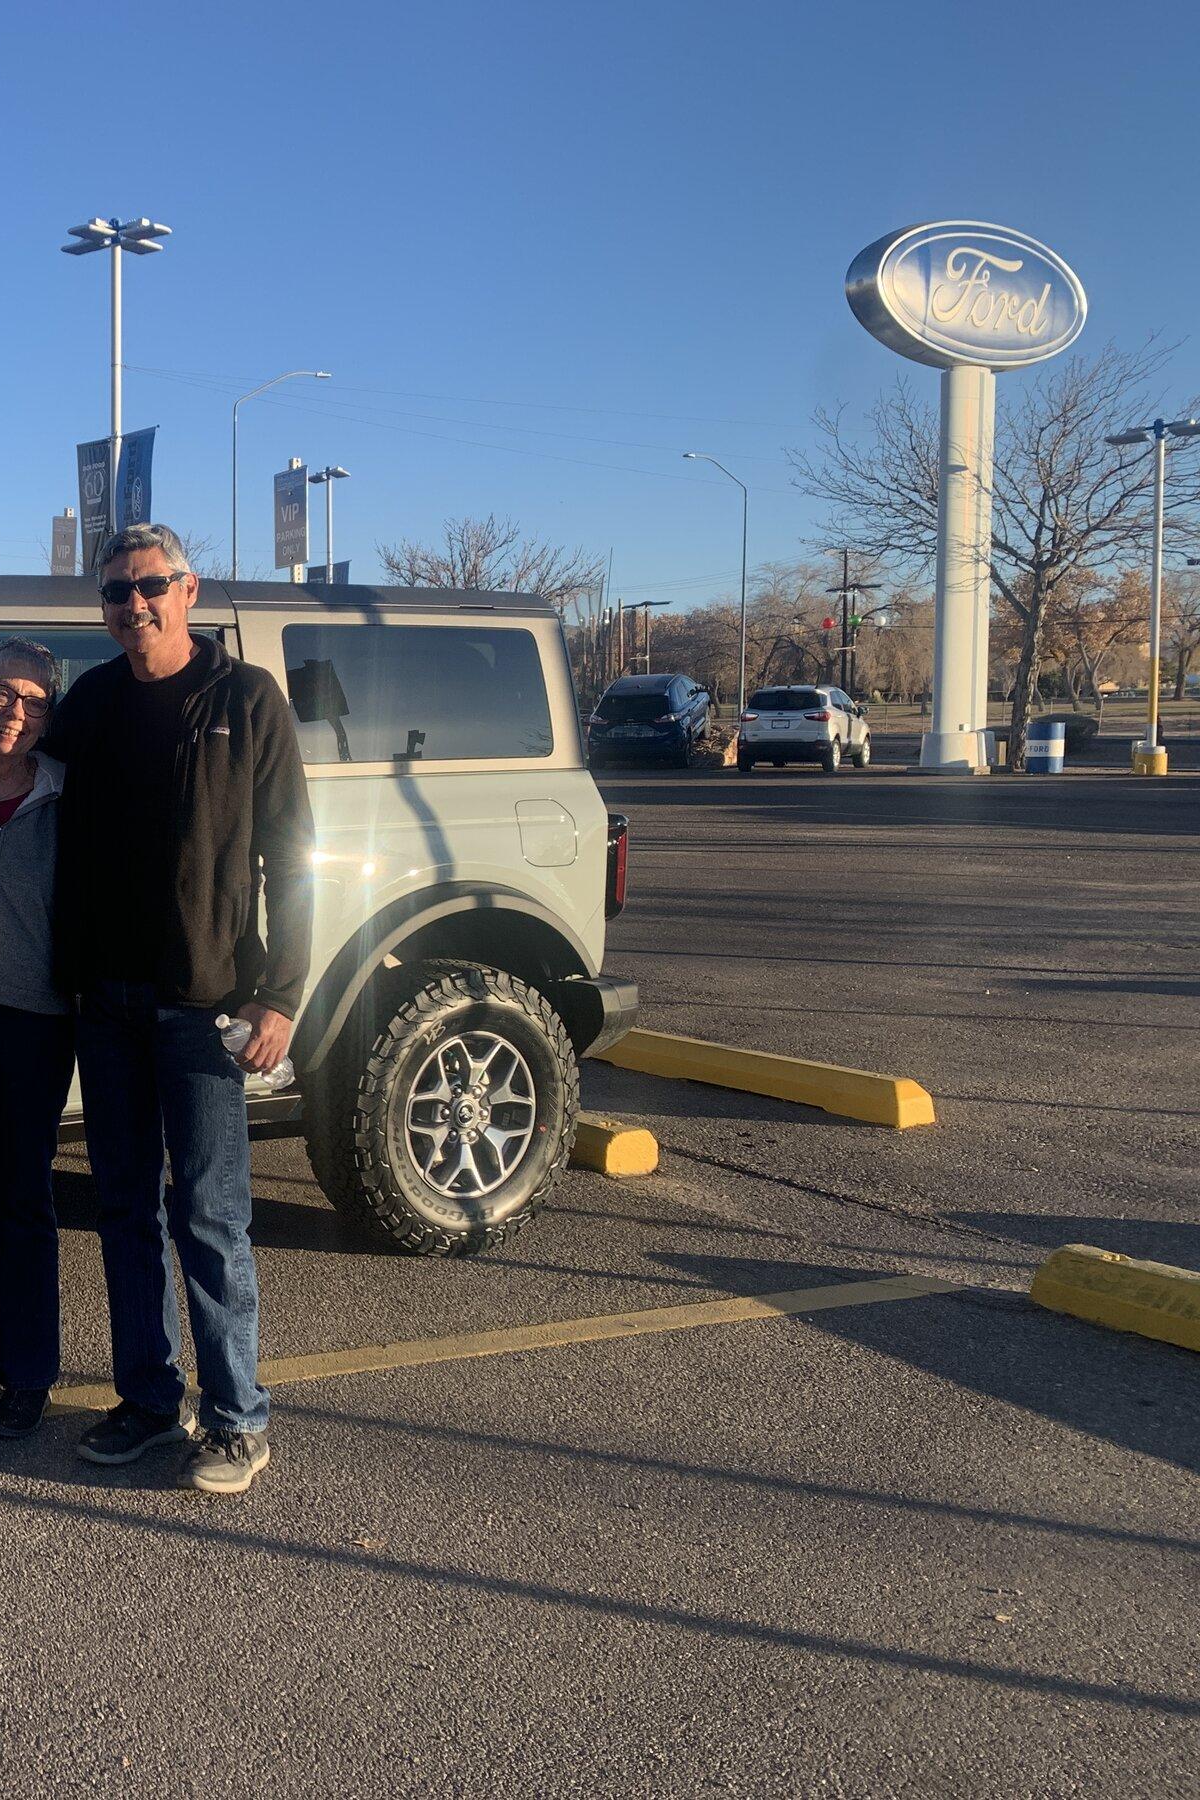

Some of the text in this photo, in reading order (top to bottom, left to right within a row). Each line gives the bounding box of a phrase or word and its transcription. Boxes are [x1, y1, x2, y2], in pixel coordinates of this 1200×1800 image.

[931, 246, 1052, 336] Ford
[281, 502, 300, 522] VIP
[276, 526, 305, 543] PARKING
[56, 544, 71, 559] VIP
[282, 542, 301, 556] ONLY
[1030, 745, 1050, 753] FORD
